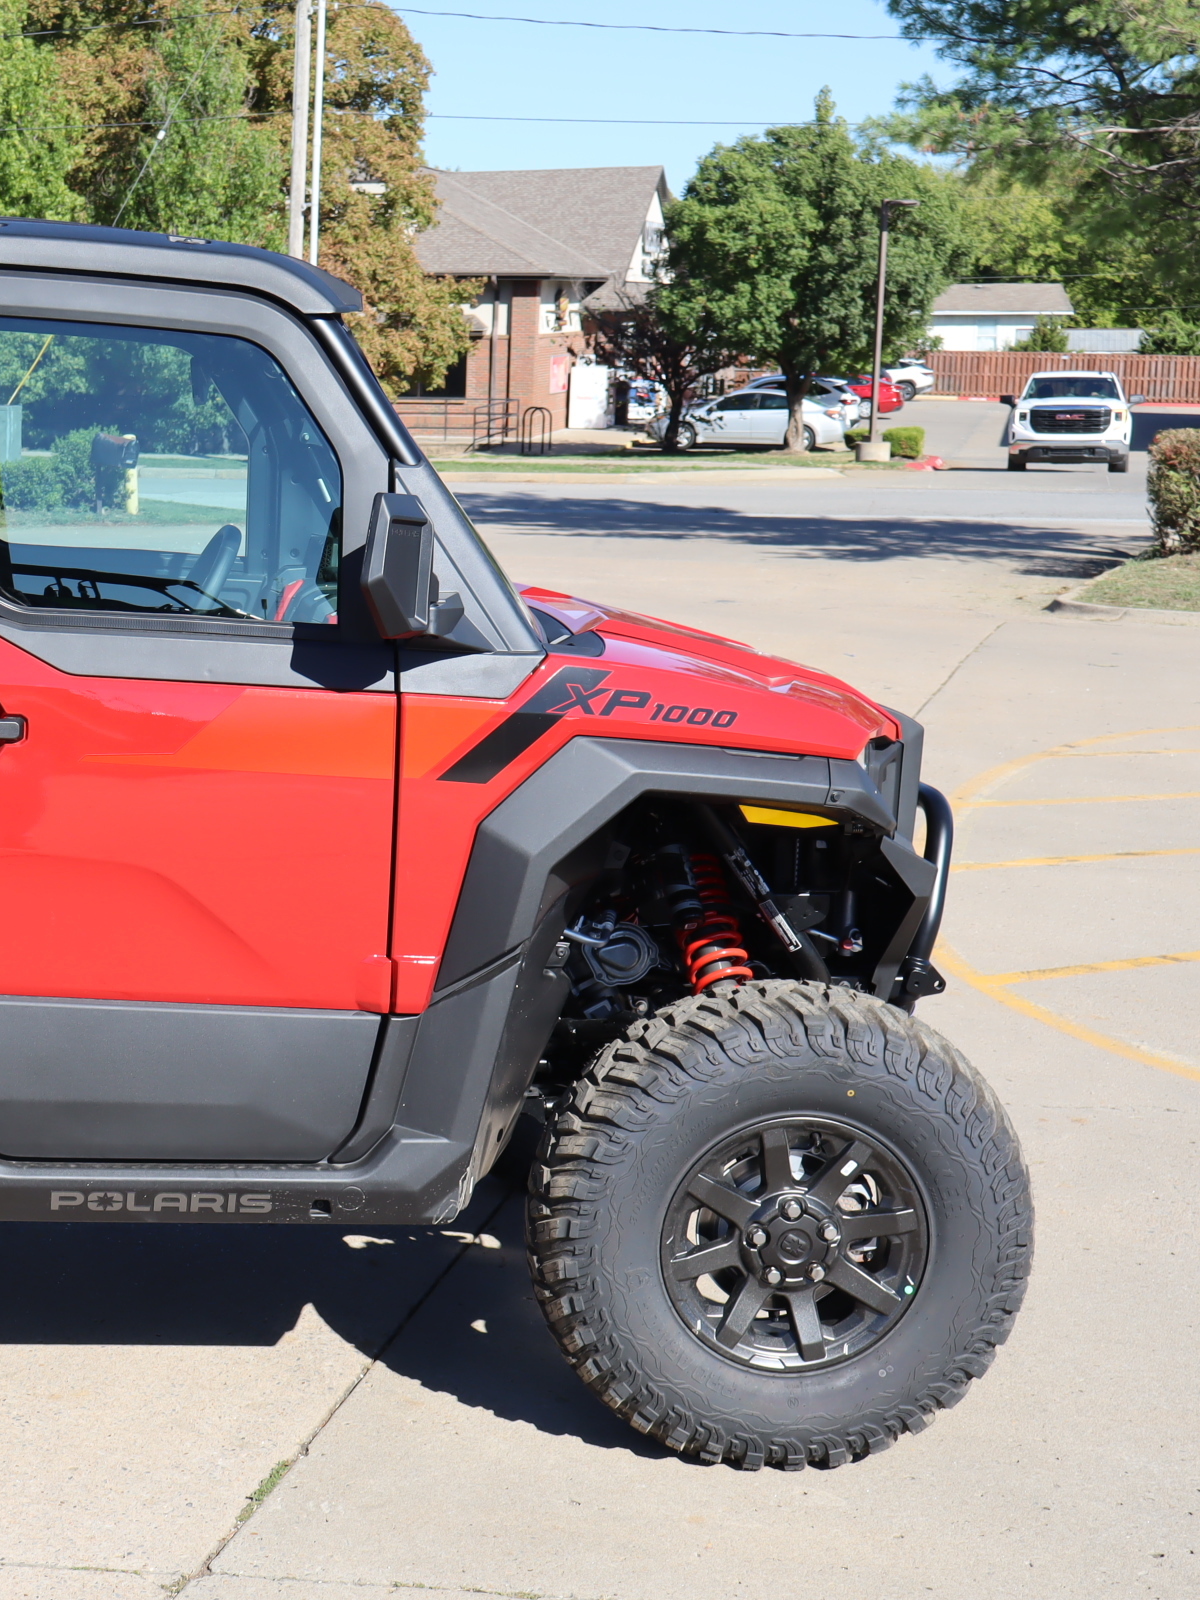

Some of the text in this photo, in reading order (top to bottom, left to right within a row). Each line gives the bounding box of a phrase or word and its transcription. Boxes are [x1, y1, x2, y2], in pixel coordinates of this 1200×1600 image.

[1055, 413, 1086, 421] GMC
[551, 684, 738, 728] XP 1000
[50, 1191, 273, 1214] POLARIS
